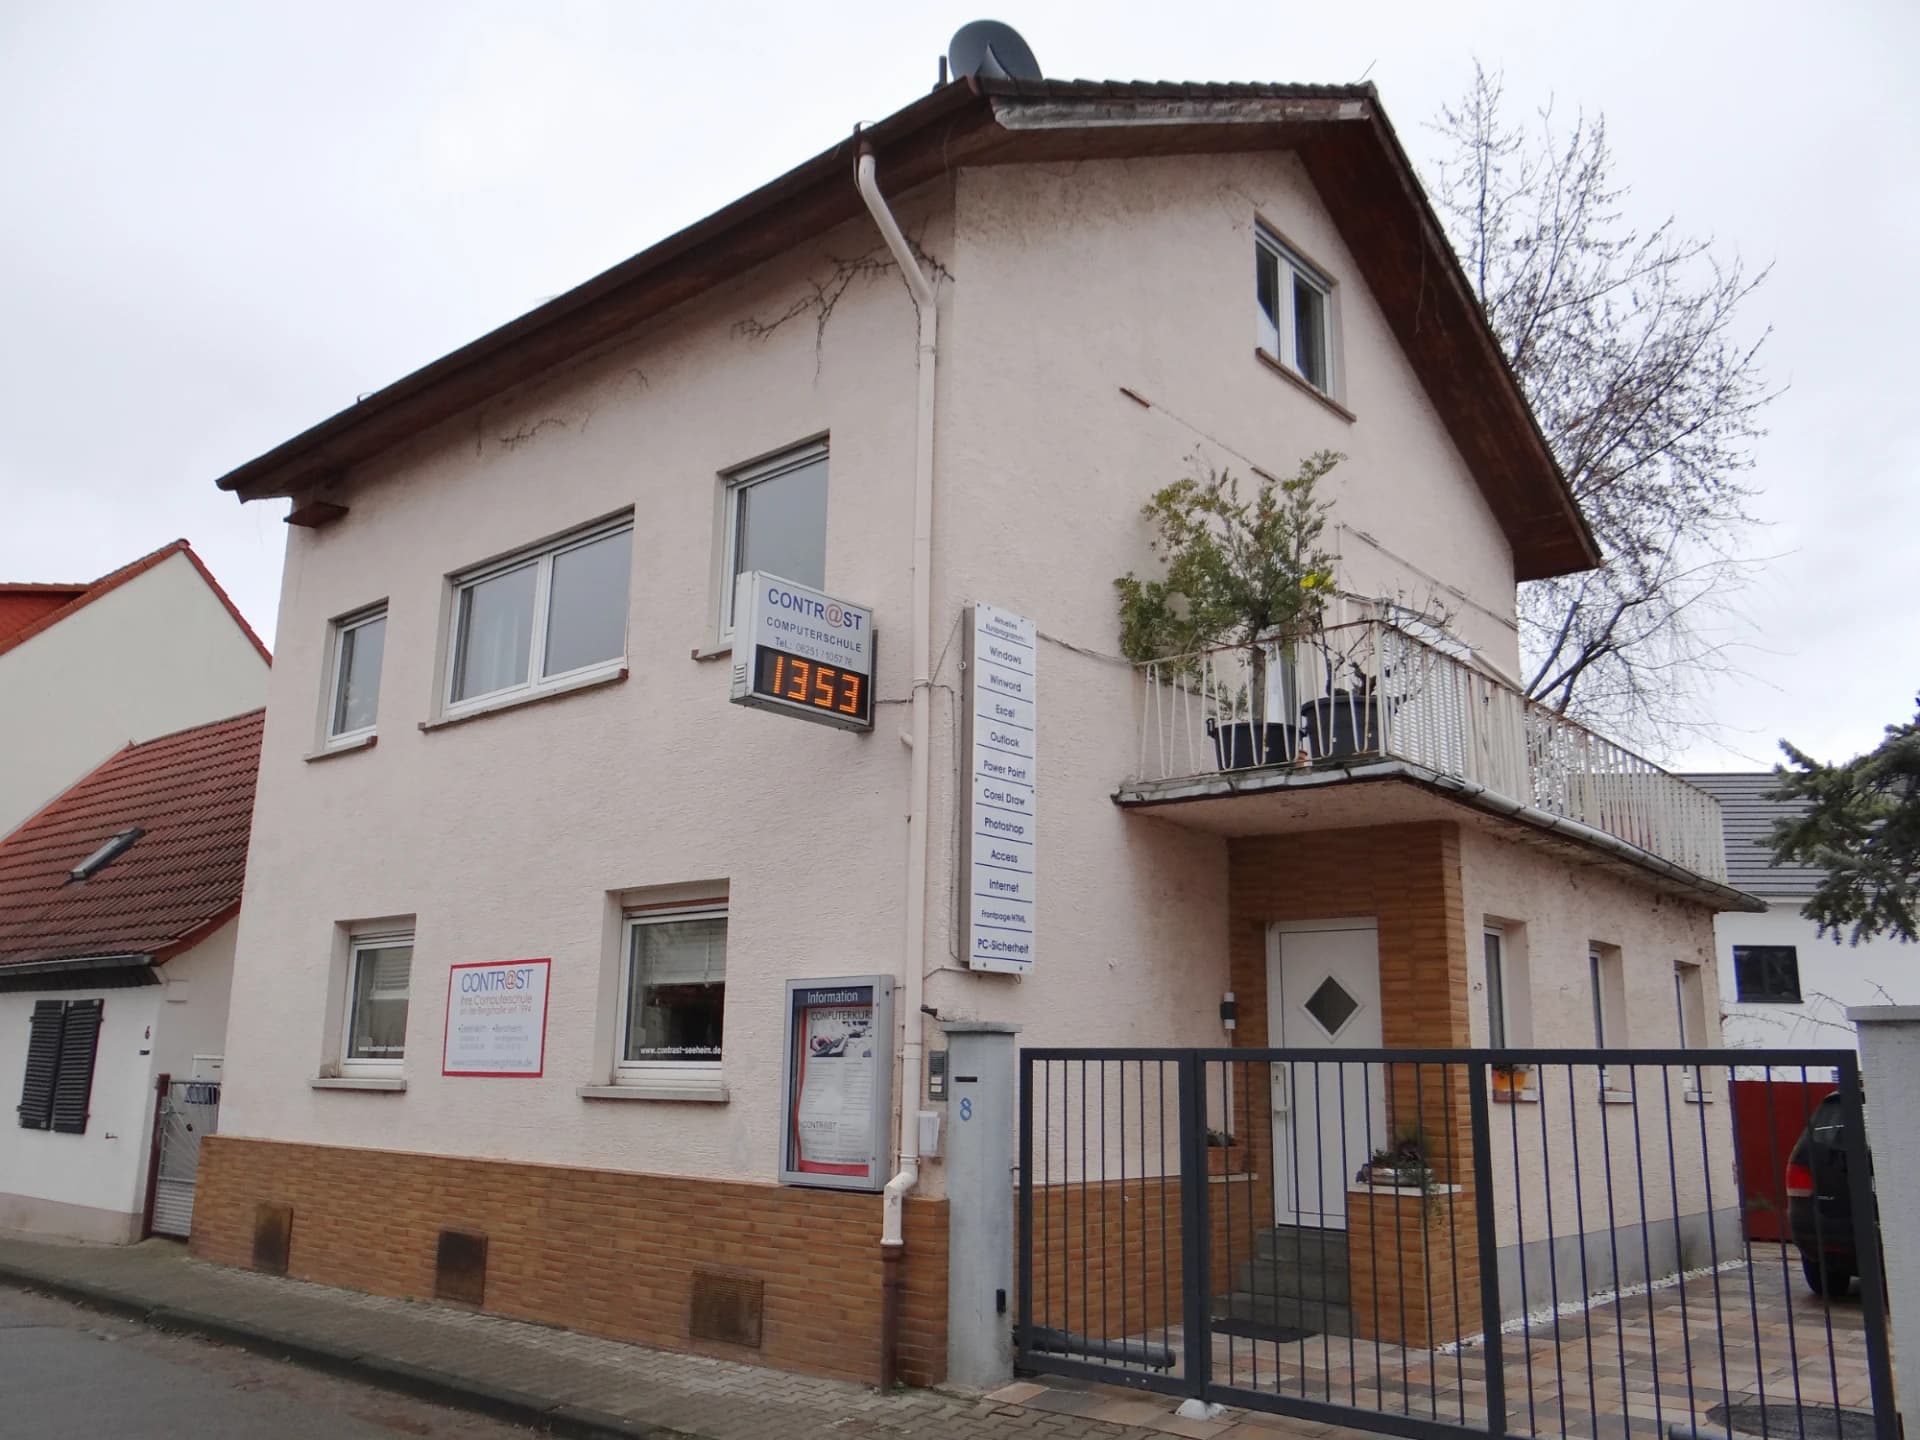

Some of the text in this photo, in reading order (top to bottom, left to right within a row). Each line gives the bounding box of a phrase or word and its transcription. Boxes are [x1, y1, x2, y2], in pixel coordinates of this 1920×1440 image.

[768, 588, 863, 630] CONTR@ST
[766, 616, 863, 653] COMPUTERSCHULE
[989, 646, 1022, 665] Windows
[990, 674, 1022, 693] Winword
[995, 703, 1015, 718] Excel
[990, 731, 1020, 748] Outlook
[983, 760, 1026, 779] Power Point
[983, 788, 1025, 806] Corel Draw
[984, 817, 1024, 835] Photoshop
[991, 849, 1018, 863] Access
[989, 878, 1019, 893] Internet
[977, 938, 1029, 954] PC-Sicherheit
[462, 968, 534, 993] CONTR@ST
[807, 991, 858, 1004] Information
[960, 1097, 972, 1121] 8
